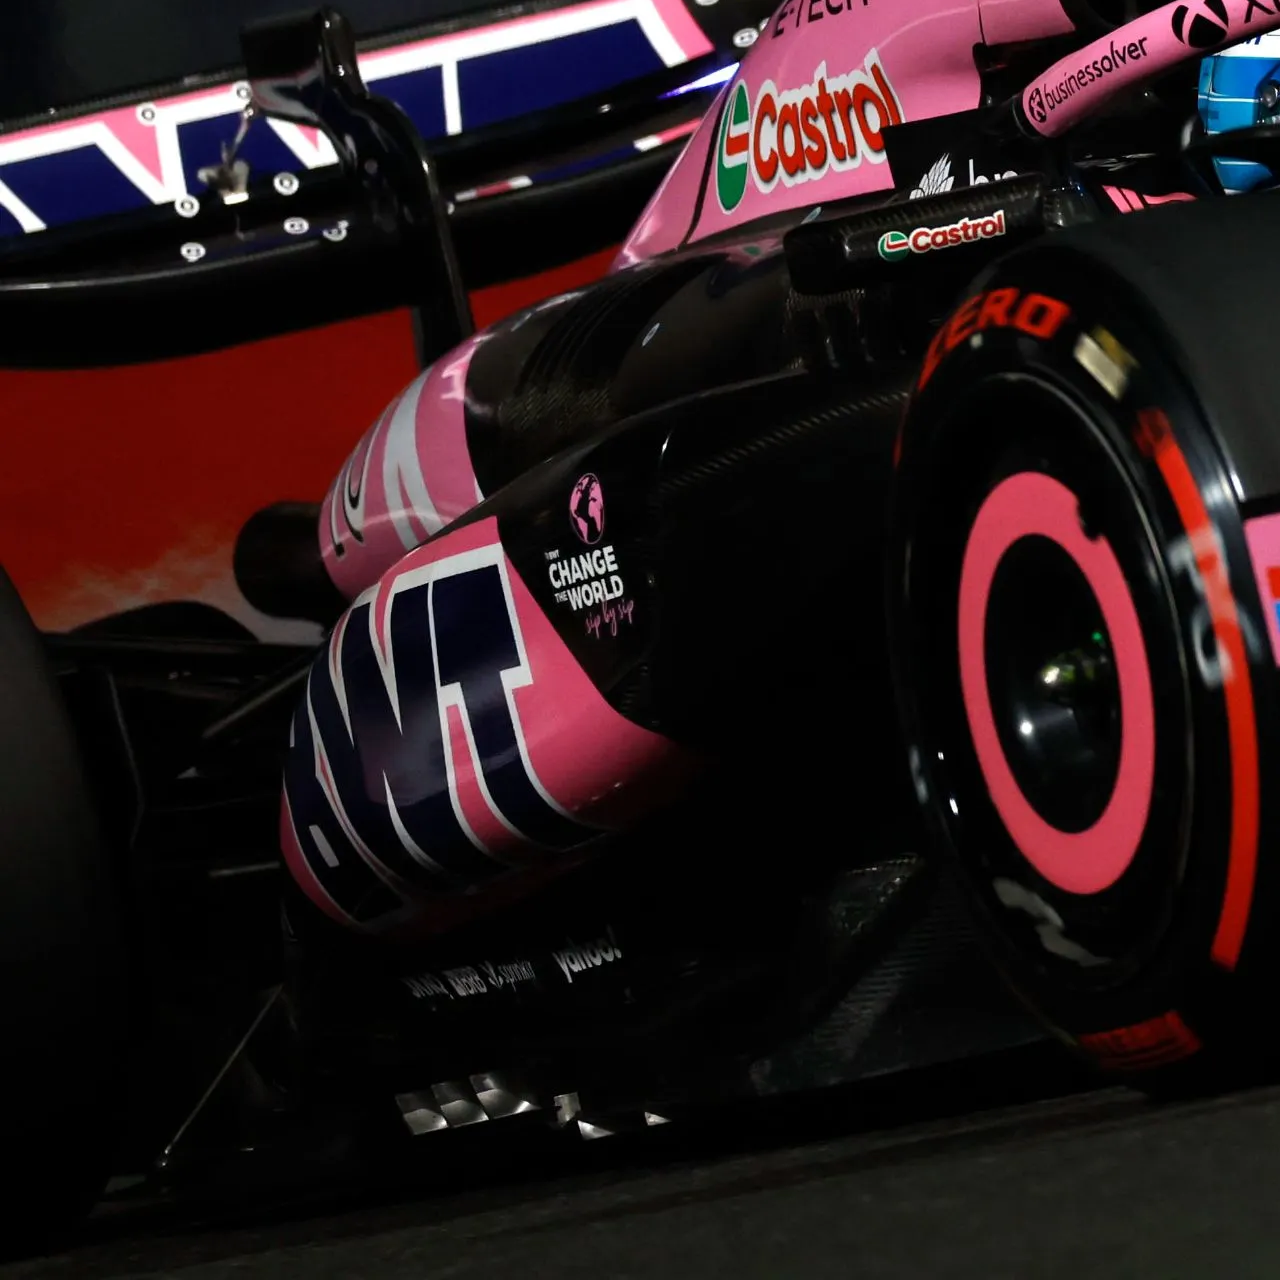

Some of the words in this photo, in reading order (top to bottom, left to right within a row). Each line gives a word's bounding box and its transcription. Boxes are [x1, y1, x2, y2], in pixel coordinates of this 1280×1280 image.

[1044, 36, 1150, 111] businessolver
[751, 56, 901, 187] Castrol
[911, 210, 1006, 253] Castrol
[917, 286, 1071, 393] ZERO
[548, 545, 619, 589] CHANGE
[554, 590, 569, 603] THE
[566, 574, 625, 611] WORLD
[585, 611, 601, 639] sip
[601, 599, 618, 637] by
[617, 598, 634, 625] sip
[552, 923, 622, 984] yahoo!
